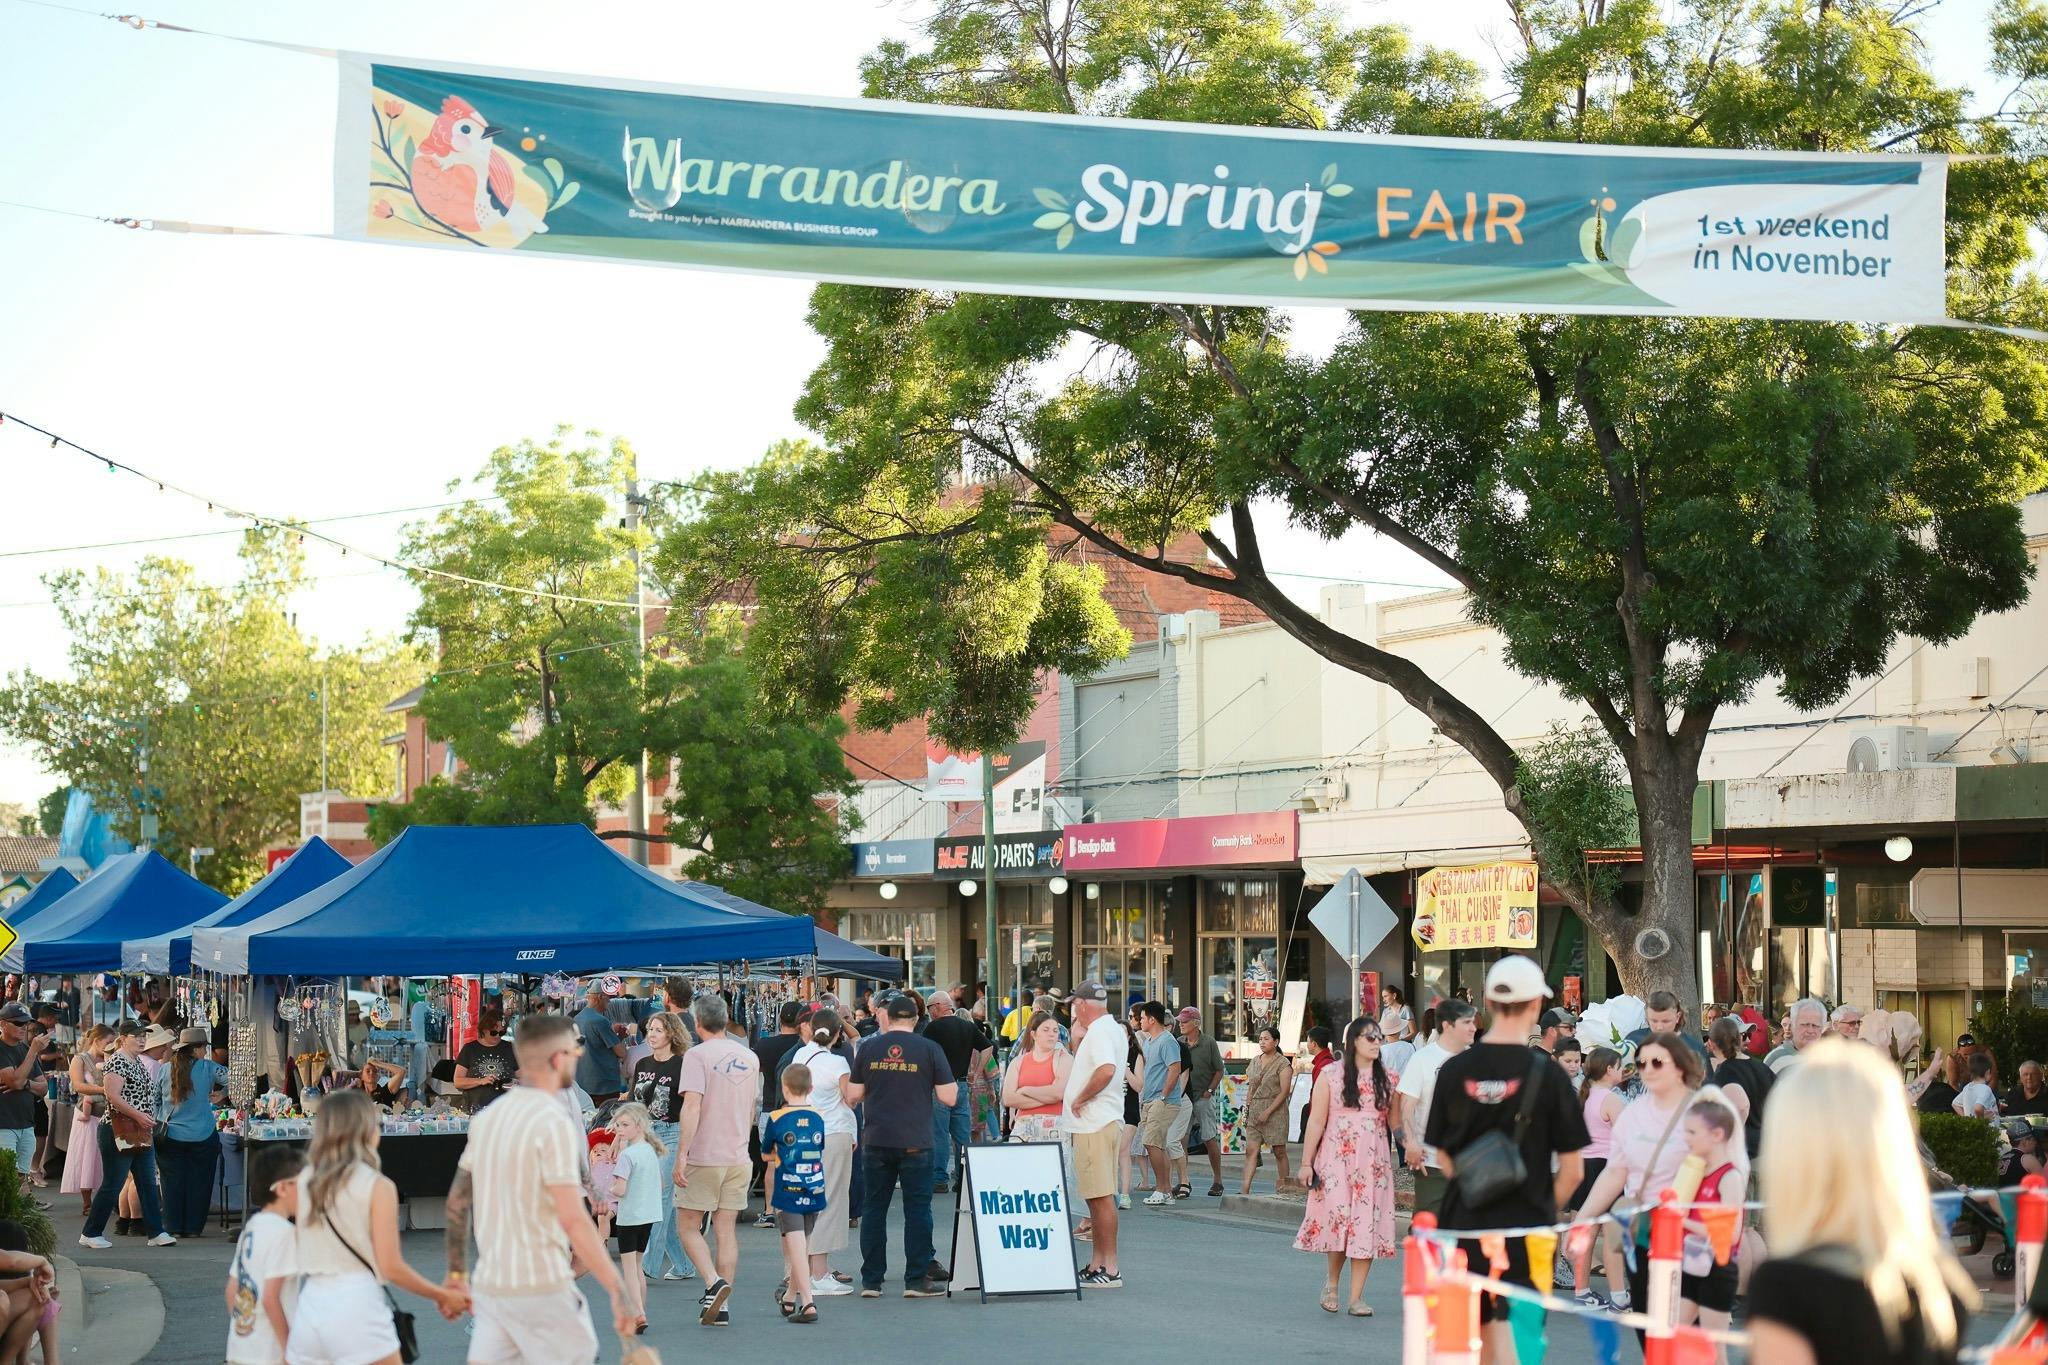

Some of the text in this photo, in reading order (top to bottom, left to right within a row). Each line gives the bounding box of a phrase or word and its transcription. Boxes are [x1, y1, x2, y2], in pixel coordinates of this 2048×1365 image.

[622, 137, 1527, 255] Narrandera Spring FAIR
[628, 208, 879, 237] Brought to you by the NARRANDERA BUSINESS GROUP
[1697, 213, 1889, 240] 1st weekend
[1694, 243, 1891, 277] in November
[1078, 837, 1116, 857] Bendigo Bank
[1212, 835, 1239, 848] Community
[1240, 834, 1252, 846] Bank
[1001, 843, 1034, 867] PARTS
[1440, 895, 1502, 923] THAI CUISINE
[516, 949, 556, 960] KINGS
[980, 1189, 1061, 1215] Market
[999, 1225, 1049, 1251] Way
